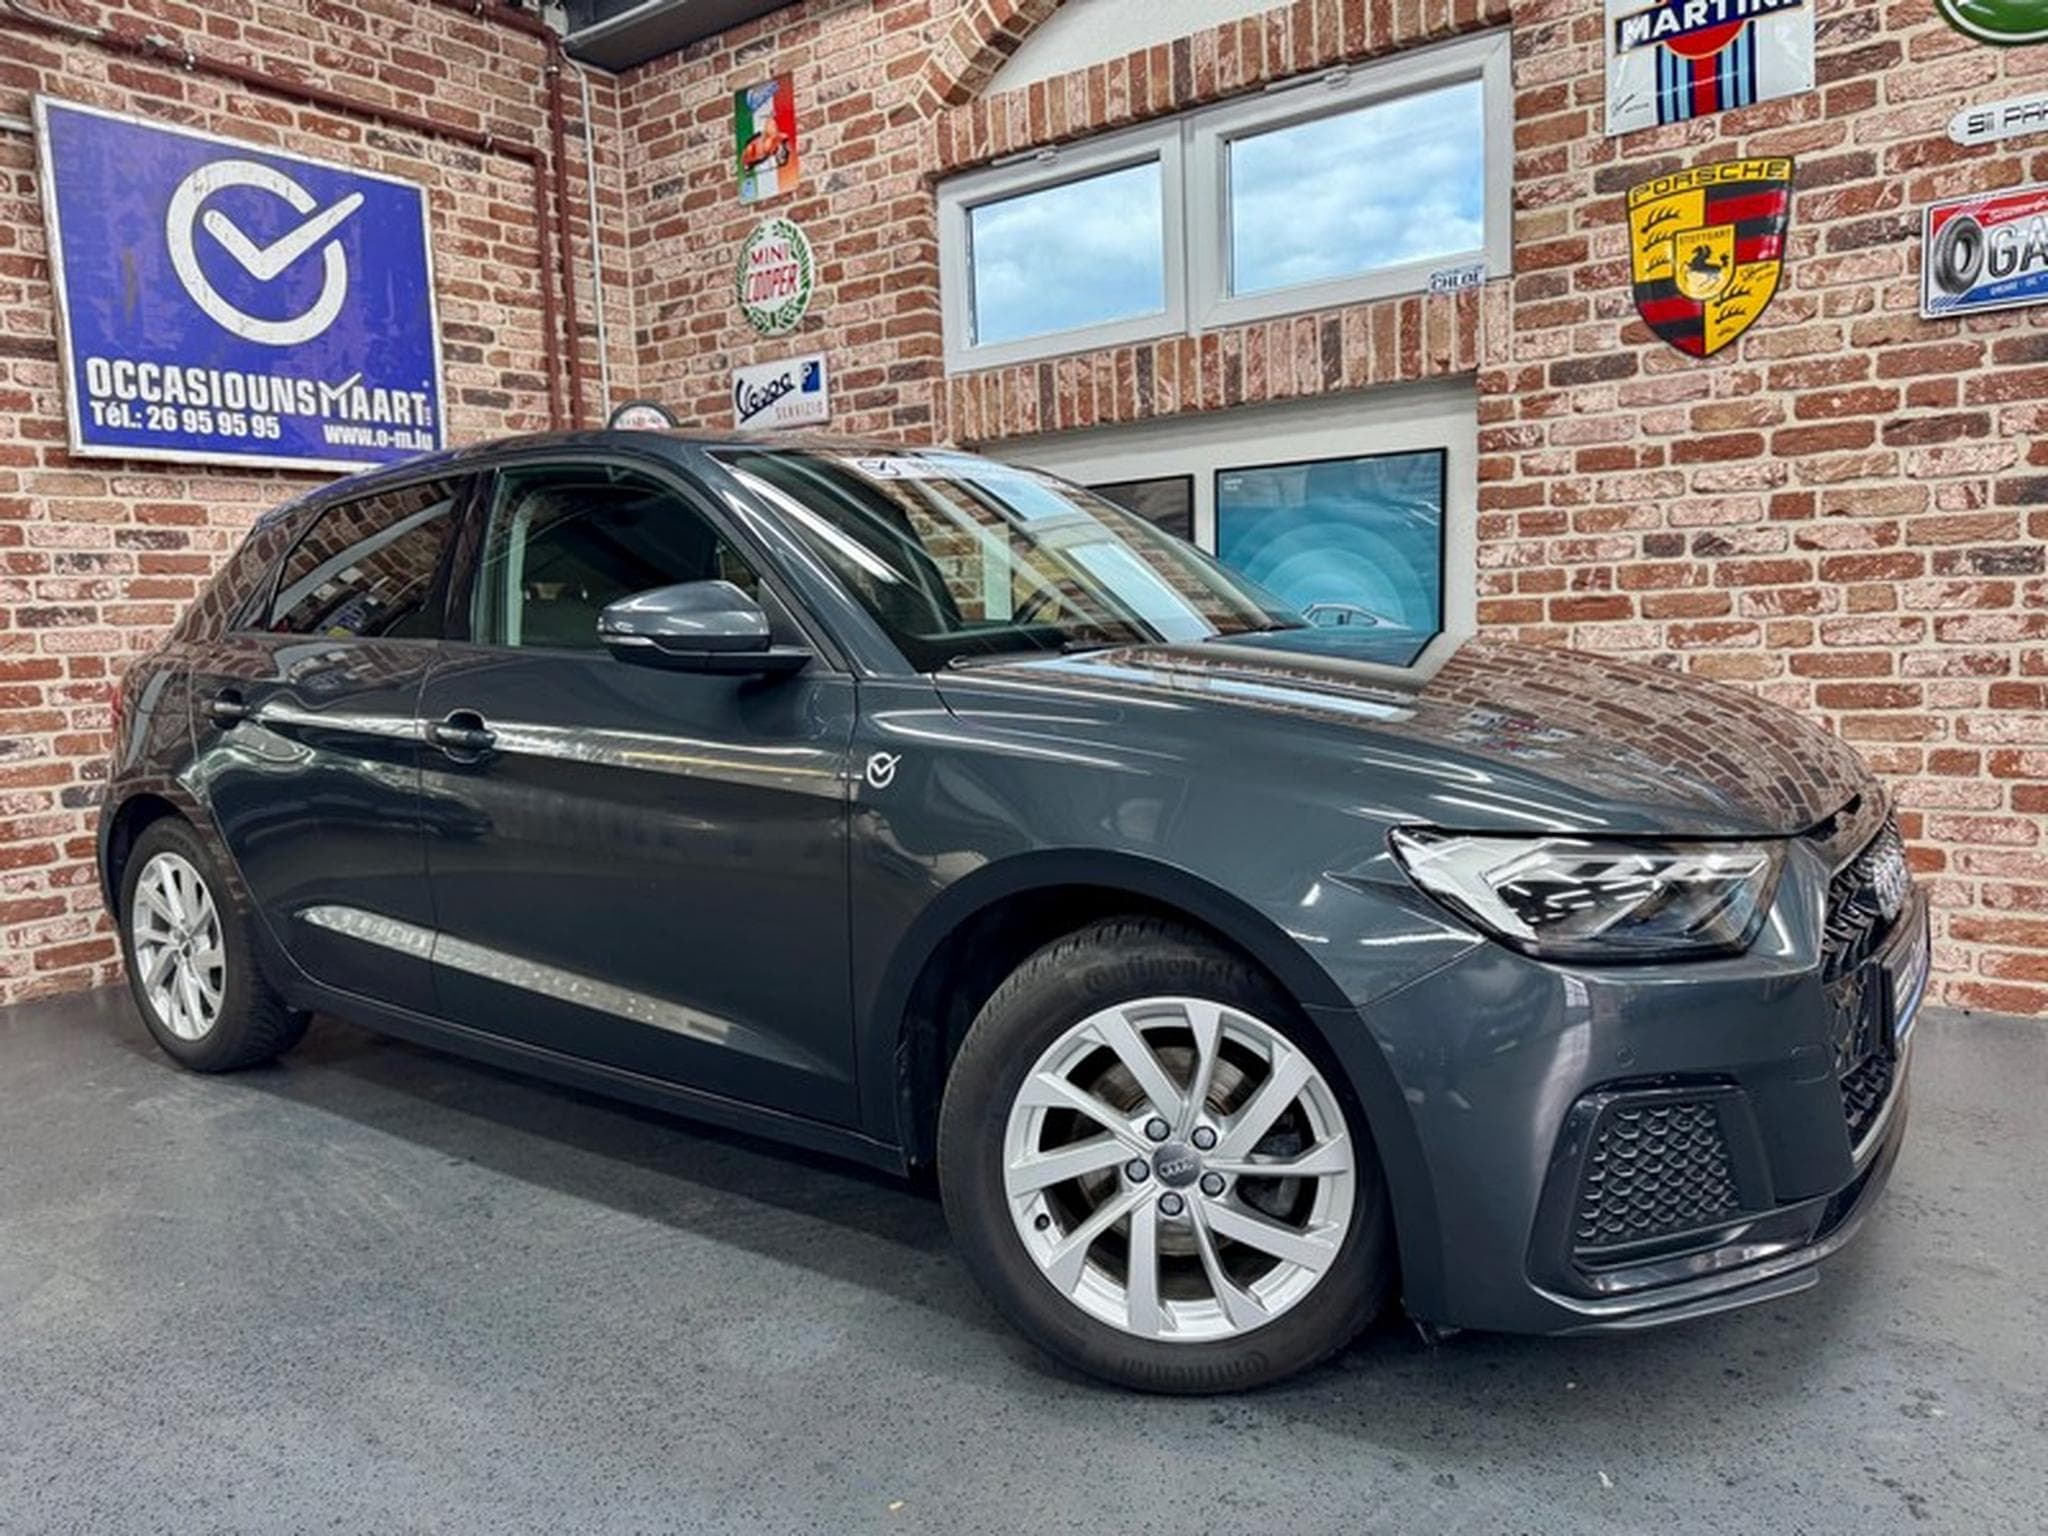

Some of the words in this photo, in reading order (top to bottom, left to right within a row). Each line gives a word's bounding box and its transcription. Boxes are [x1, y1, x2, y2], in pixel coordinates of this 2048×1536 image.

[1633, 161, 1787, 202] PORSCHE
[751, 243, 789, 265] MINI
[745, 263, 798, 303] COOPER
[86, 357, 427, 427] OCCASIOUNSMAART
[146, 405, 178, 432] 26
[182, 408, 213, 434] 95
[217, 411, 247, 437] 95
[251, 415, 281, 439] 95
[323, 424, 434, 451] www.o-m.lu
